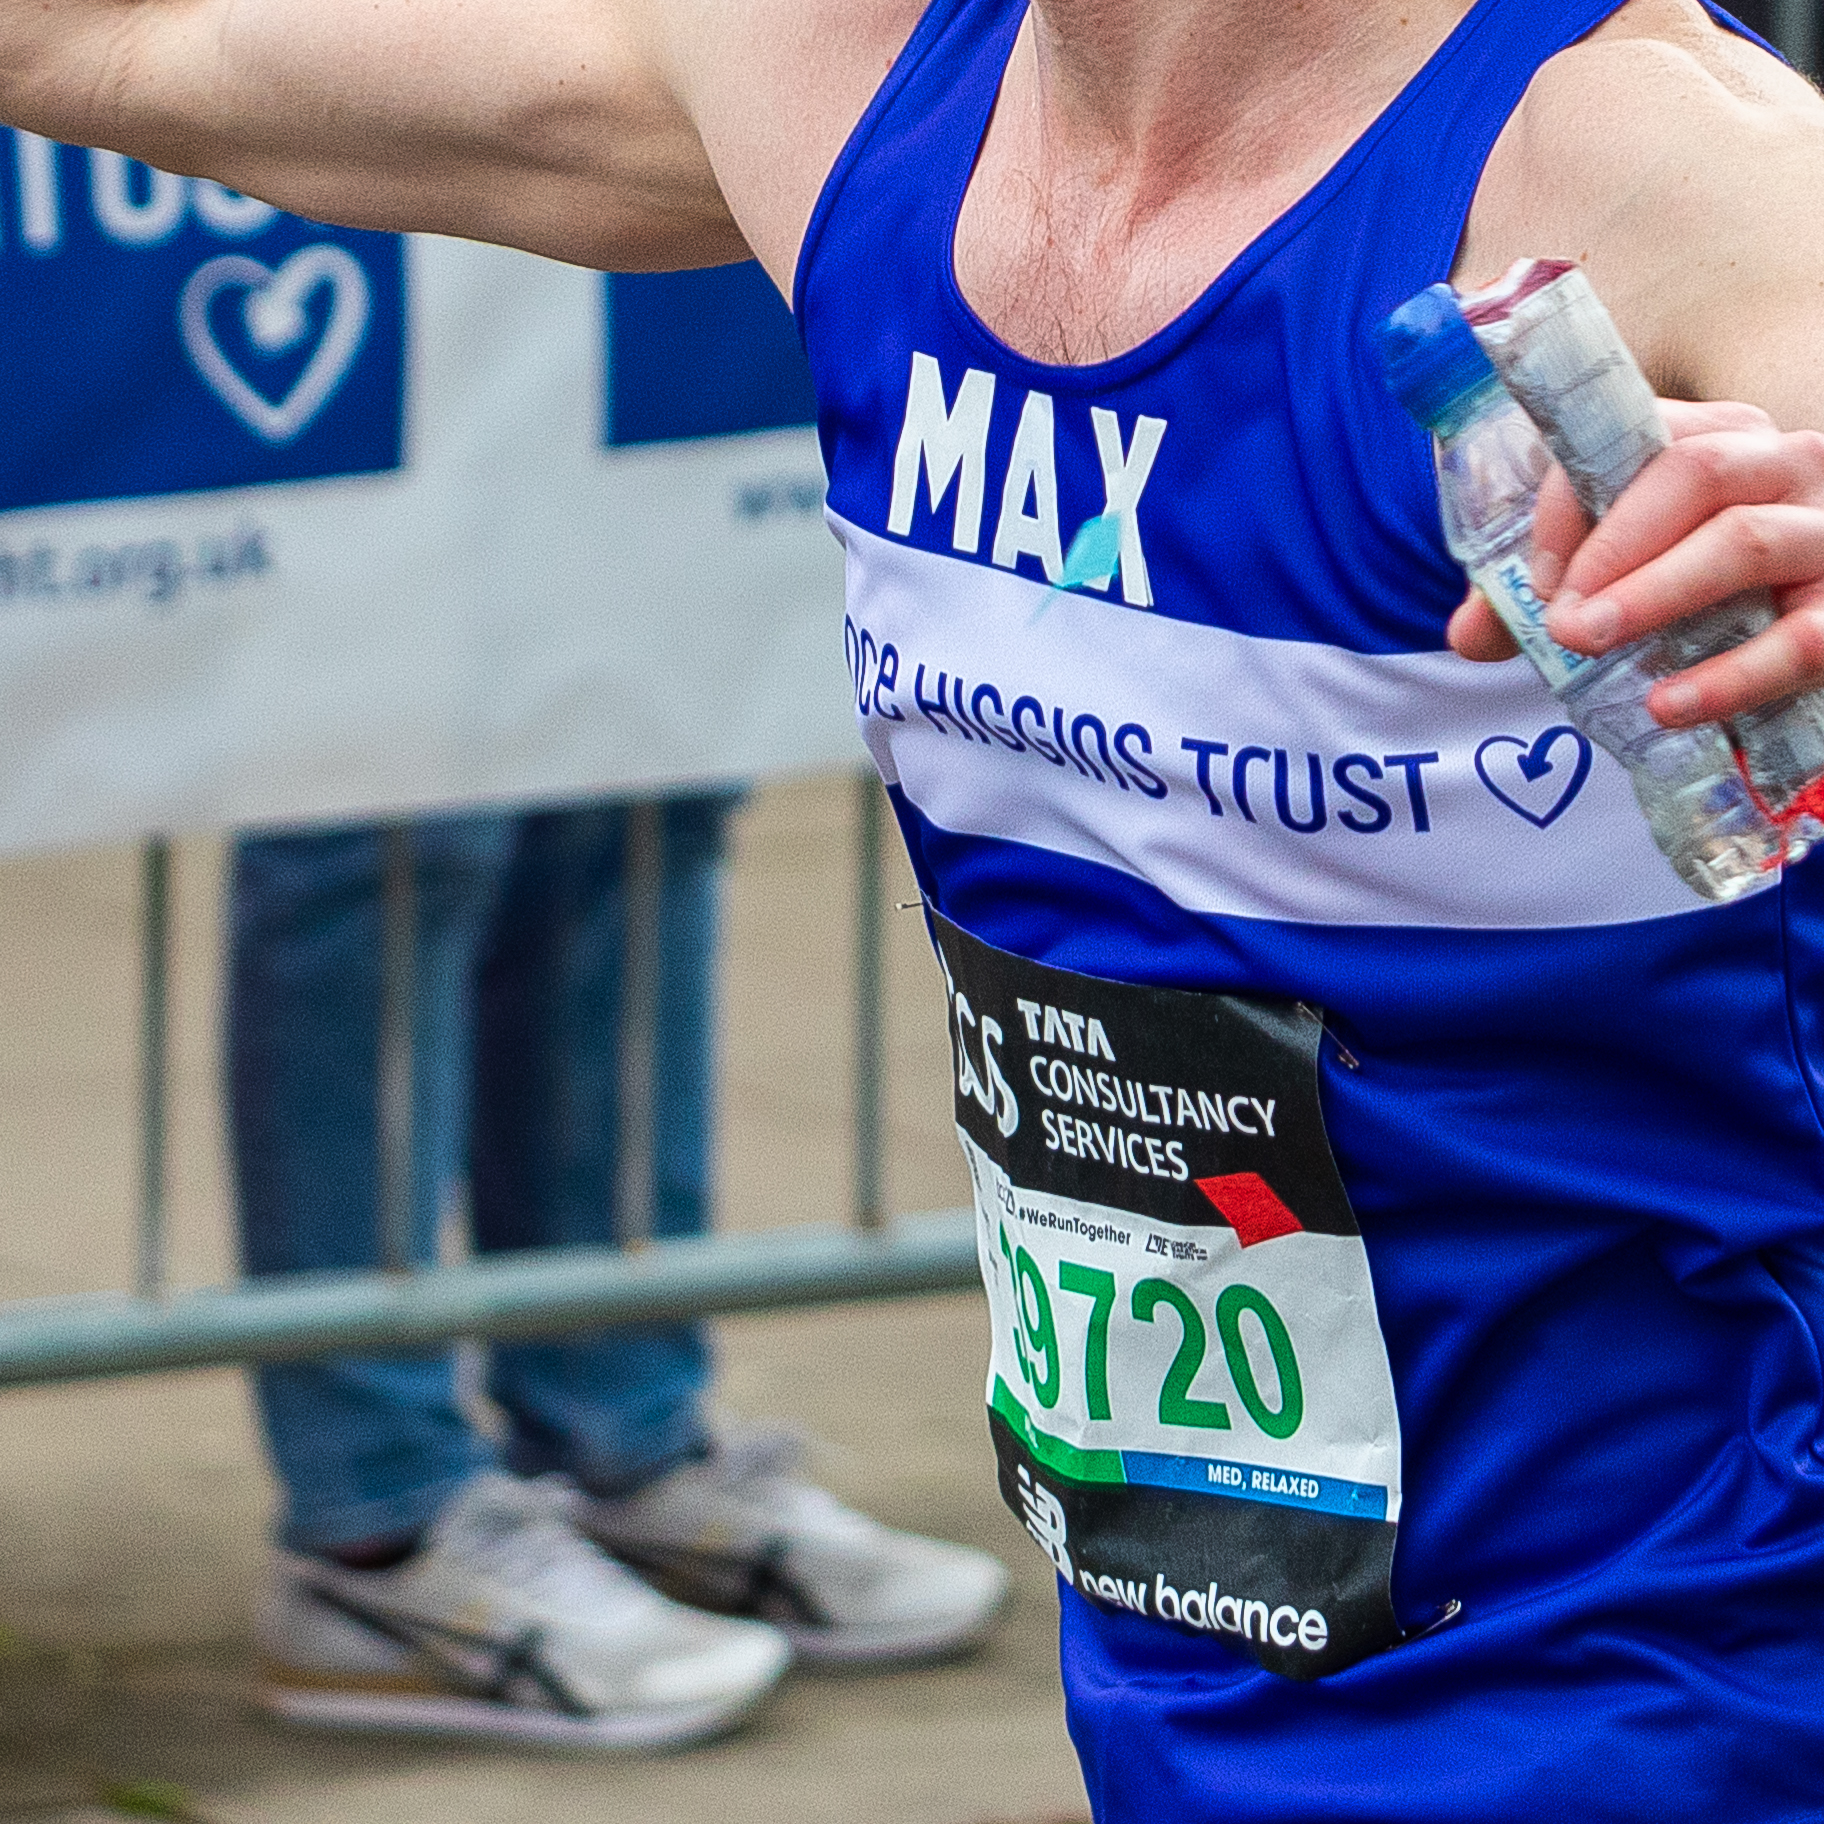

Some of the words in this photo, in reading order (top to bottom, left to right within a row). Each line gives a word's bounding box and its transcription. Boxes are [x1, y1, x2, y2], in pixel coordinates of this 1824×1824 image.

[887, 350, 1168, 609] MAX
[914, 662, 1169, 801] HIGGINS
[1181, 737, 1440, 836] TRUST
[1016, 997, 1116, 1062] TATA
[1029, 1055, 1277, 1138] CONSULTANCY
[1040, 1108, 1190, 1182] SERVICES
[1019, 1206, 1132, 1246] #WeRunTogether
[1207, 1464, 1247, 1492] MED,
[1252, 1469, 1319, 1500] RELAXED
[1079, 1568, 1147, 1616] new
[1154, 1573, 1329, 1652] balance
